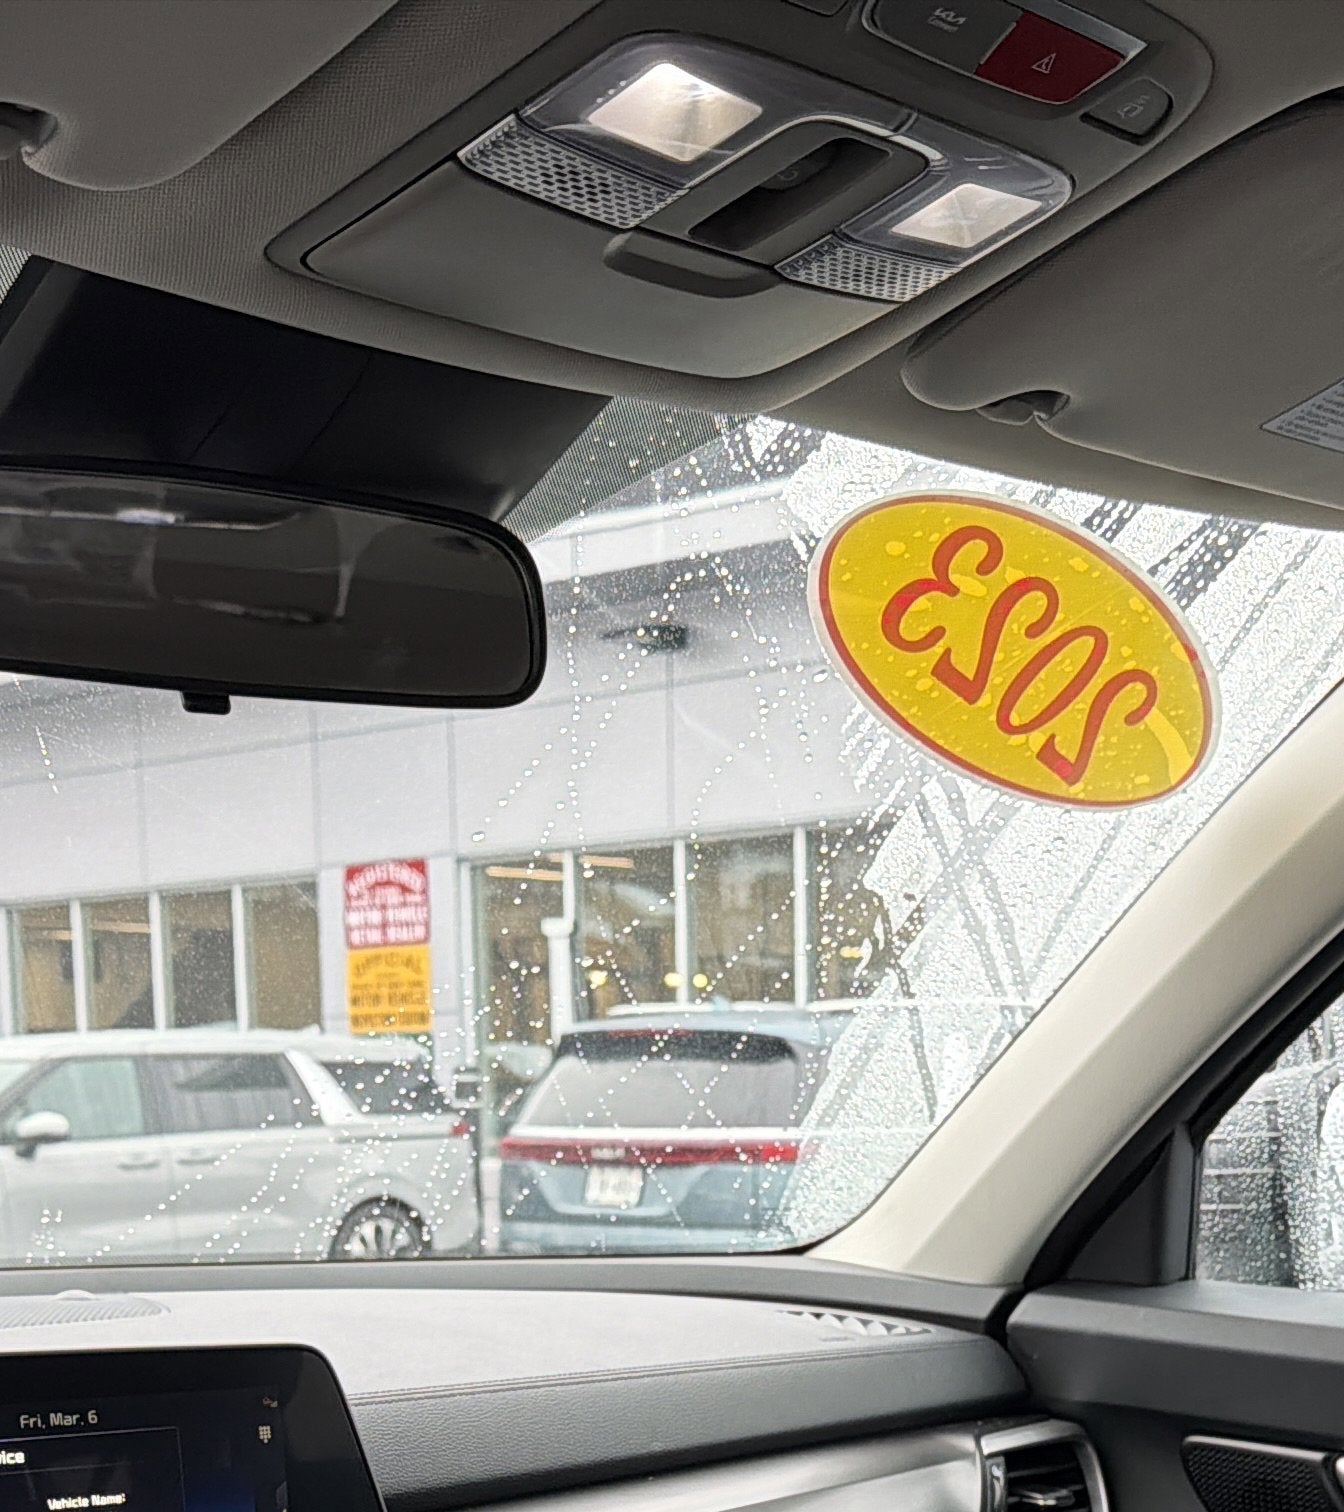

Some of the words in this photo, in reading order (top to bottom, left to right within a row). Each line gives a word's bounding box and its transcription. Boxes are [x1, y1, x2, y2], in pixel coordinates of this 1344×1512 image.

[19, 1414, 46, 1429] Fri,
[49, 1412, 85, 1427] Mar.
[87, 1410, 98, 1424] 6
[47, 1496, 89, 1511] Vehicle
[91, 1493, 126, 1507] Name:
